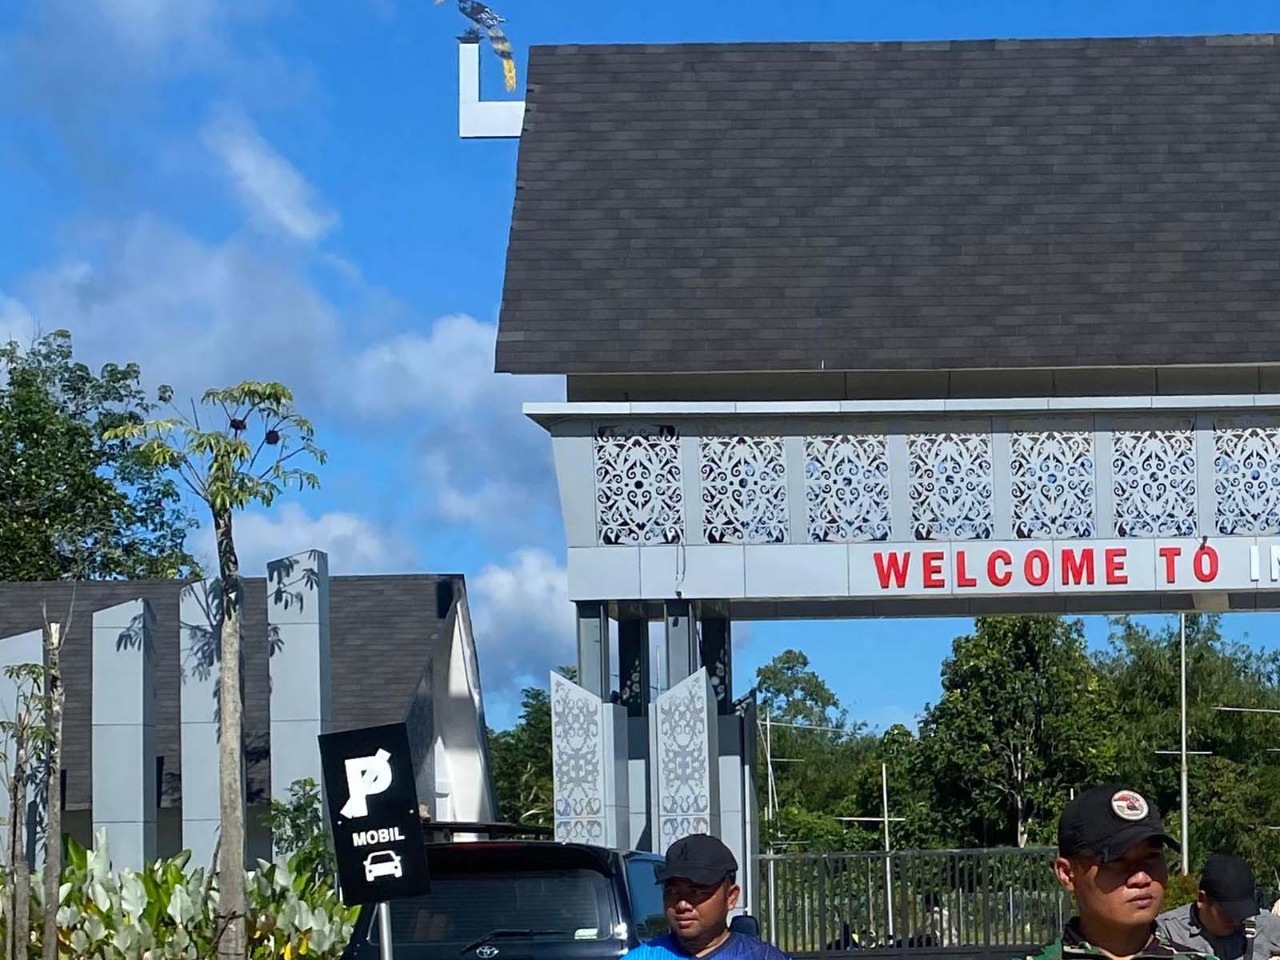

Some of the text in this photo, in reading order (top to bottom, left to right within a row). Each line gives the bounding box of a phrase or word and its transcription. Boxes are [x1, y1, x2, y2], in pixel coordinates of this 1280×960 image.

[873, 548, 1129, 589] WELCOME
[1159, 546, 1219, 584] TO
[352, 827, 405, 847] MOBIL
